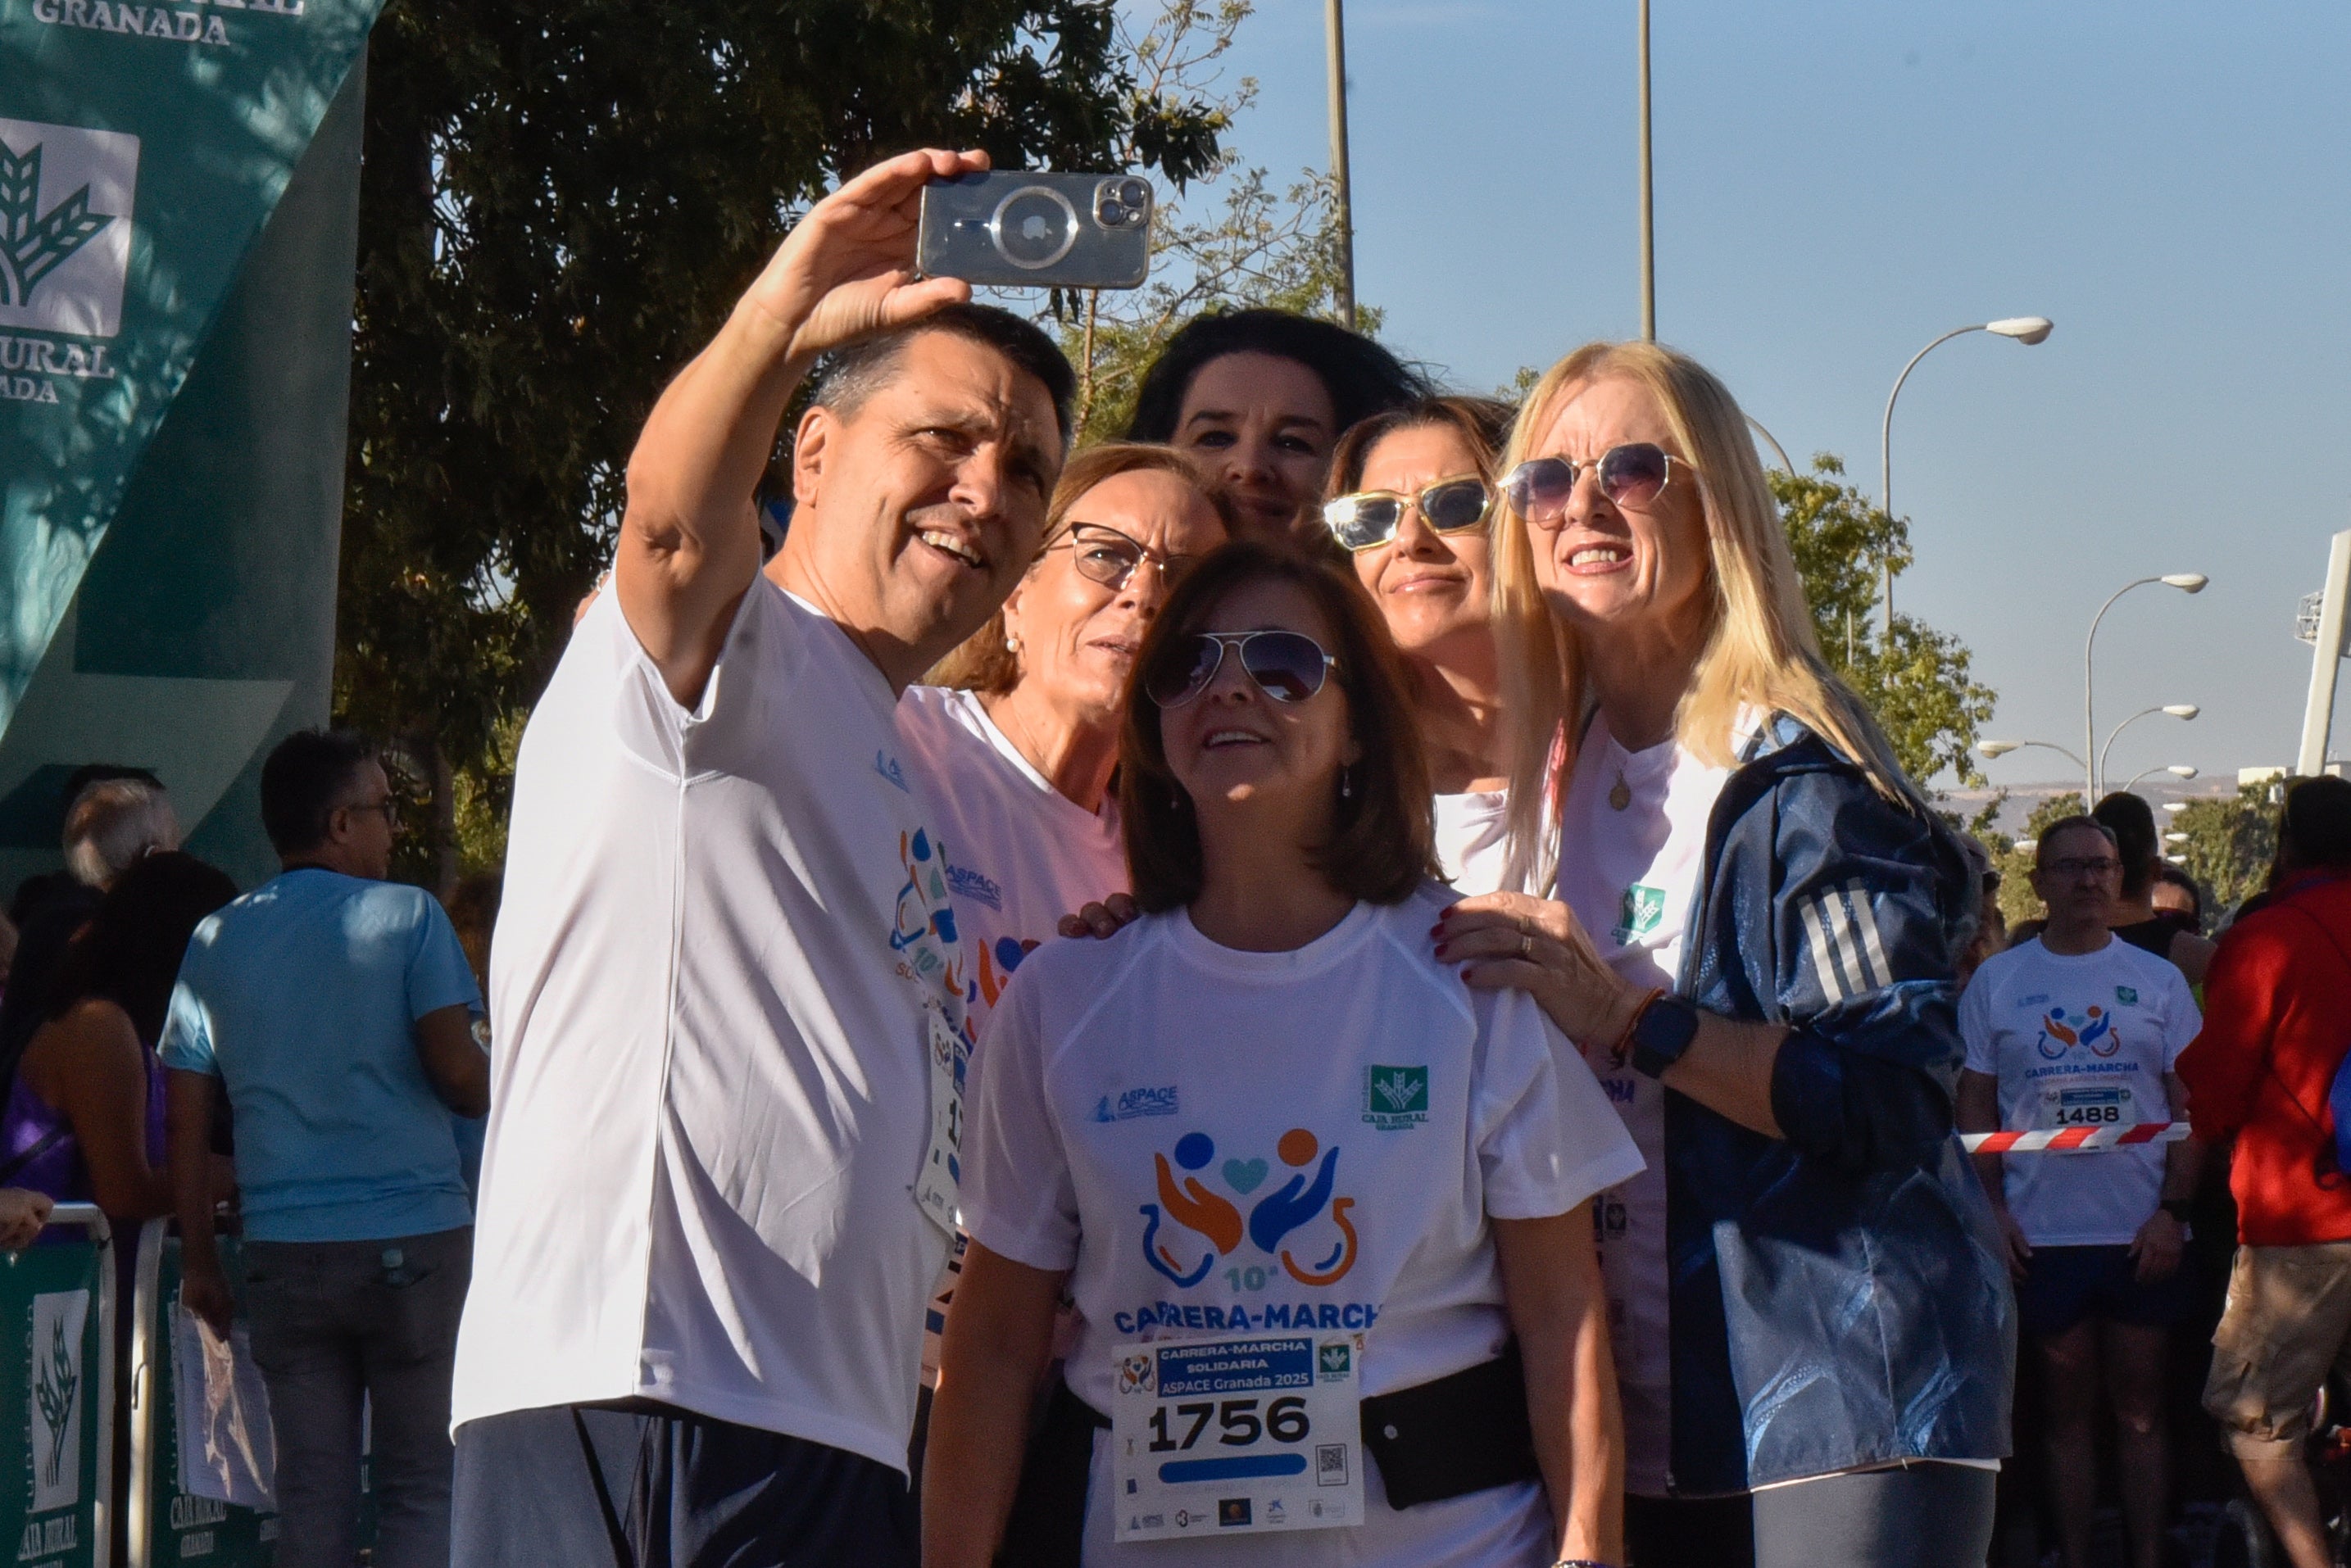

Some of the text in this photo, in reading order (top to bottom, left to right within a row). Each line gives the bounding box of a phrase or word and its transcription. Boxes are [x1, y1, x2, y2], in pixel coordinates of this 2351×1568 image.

[33, 0, 230, 46] GRANADA
[945, 864, 1001, 895] ASPACE
[2025, 1063, 2139, 1078] CARRERA-MARCHA
[1119, 1086, 1177, 1110] ASPACE
[2057, 1107, 2120, 1125] 1488
[1160, 1341, 1307, 1360] CARRERA-MARCHA
[1187, 1359, 1269, 1373] SOLIDARIA
[1162, 1380, 1210, 1394] ASPACE
[1214, 1375, 1270, 1390] Granada
[1275, 1373, 1309, 1386] 2025
[1149, 1397, 1310, 1452] 1756
